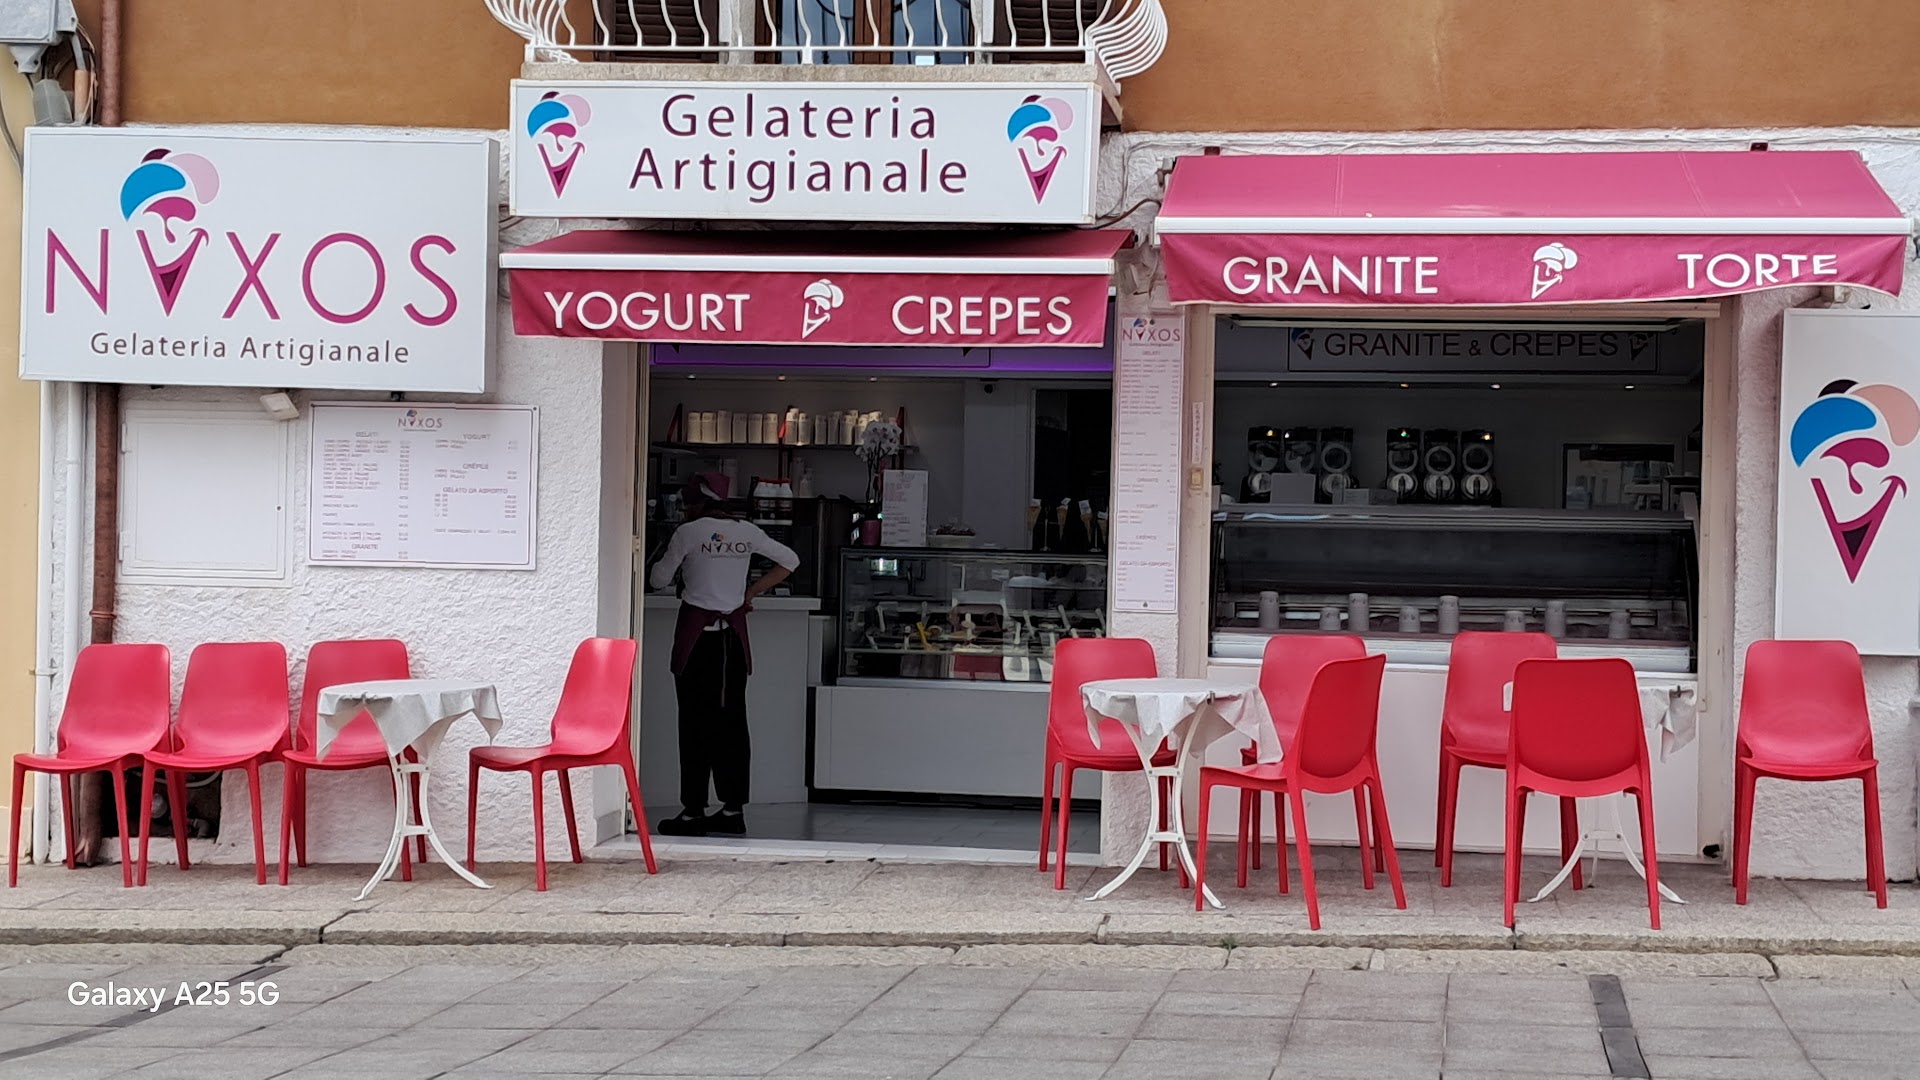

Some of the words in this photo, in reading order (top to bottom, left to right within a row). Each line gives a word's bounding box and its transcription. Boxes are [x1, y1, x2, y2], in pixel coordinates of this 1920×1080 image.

[661, 93, 937, 139] Gelateria
[628, 146, 968, 203] Artigianale
[1221, 254, 1440, 296] GRANITE
[1677, 252, 1839, 290] TORTE
[543, 290, 751, 333] YOGURT
[891, 295, 1073, 337] CREPES
[90, 332, 227, 358] Gelateria
[239, 335, 410, 367] Artigianale
[1324, 332, 1461, 357] GRANITE
[1468, 340, 1483, 357] &
[1490, 331, 1619, 358] CREPES
